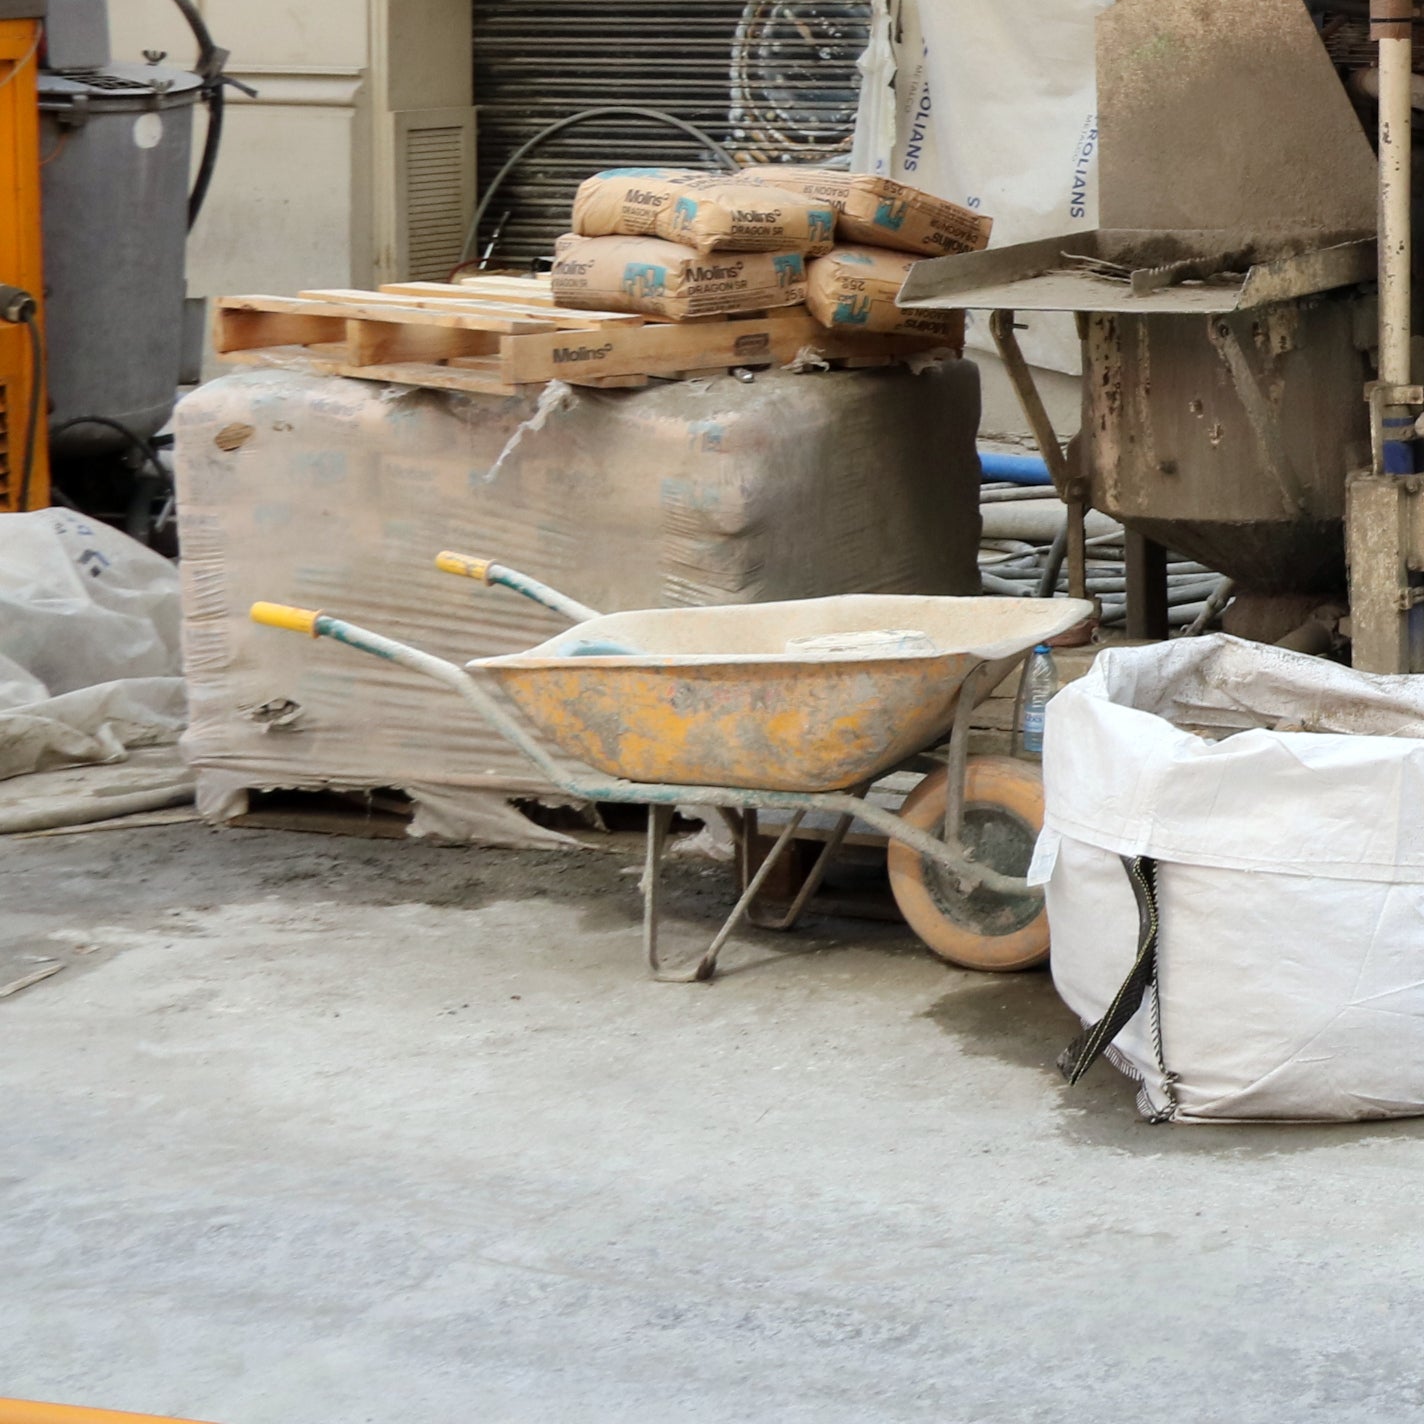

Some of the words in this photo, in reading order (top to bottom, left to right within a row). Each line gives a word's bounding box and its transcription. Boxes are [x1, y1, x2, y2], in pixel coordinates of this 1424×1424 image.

[1070, 116, 1099, 218] ROLIANS
[624, 189, 662, 207] Molins
[730, 210, 776, 223] Molins
[731, 225, 770, 236] DRAGON
[772, 227, 784, 235] SR
[686, 265, 739, 284] Molins
[688, 283, 734, 296] DRAGON
[735, 280, 747, 290] SR
[553, 346, 606, 363] Molins
